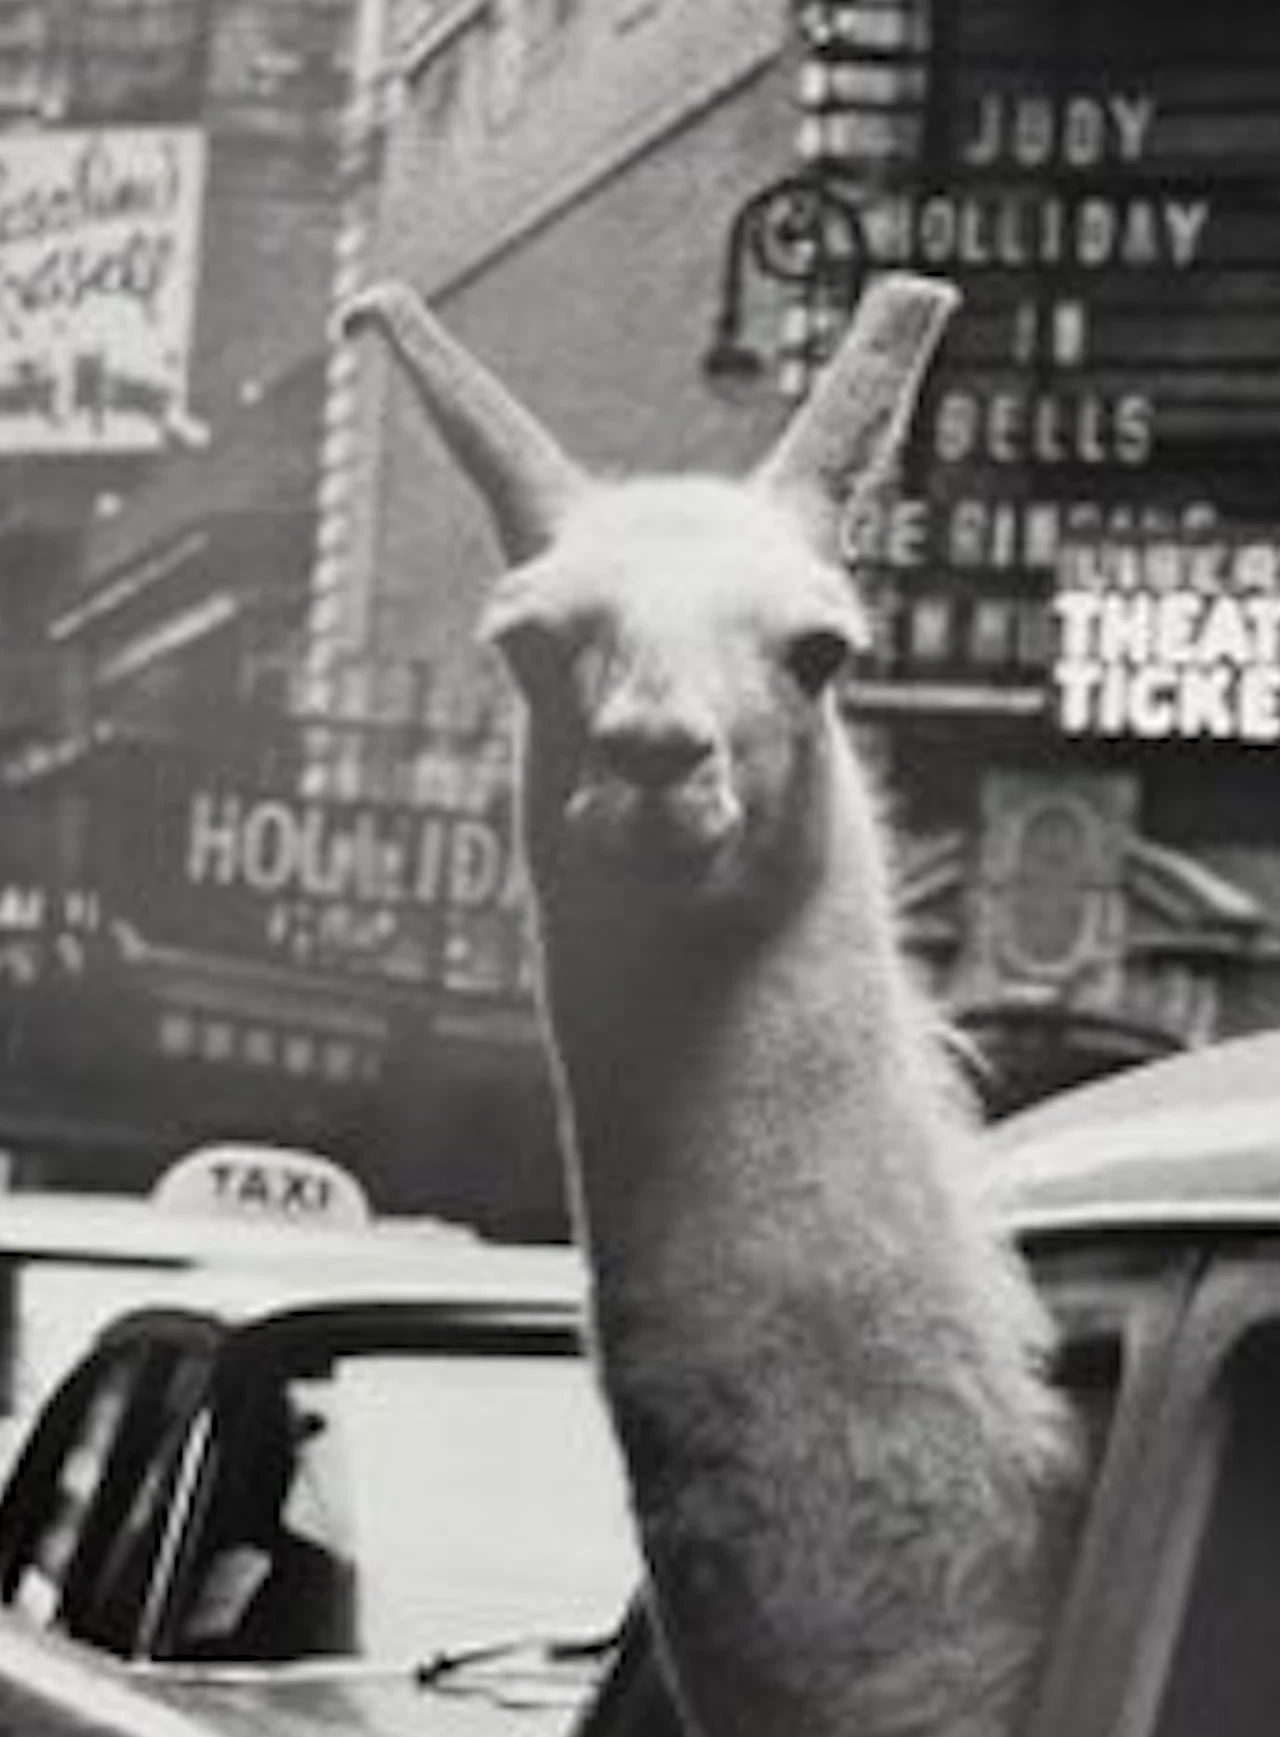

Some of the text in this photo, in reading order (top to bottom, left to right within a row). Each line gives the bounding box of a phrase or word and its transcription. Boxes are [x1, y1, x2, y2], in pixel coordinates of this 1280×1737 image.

[963, 92, 1154, 165] JUDY
[862, 198, 1208, 265] HOLLIDAY
[933, 392, 1153, 464] BELLS
[210, 1164, 333, 1213] TAXI
